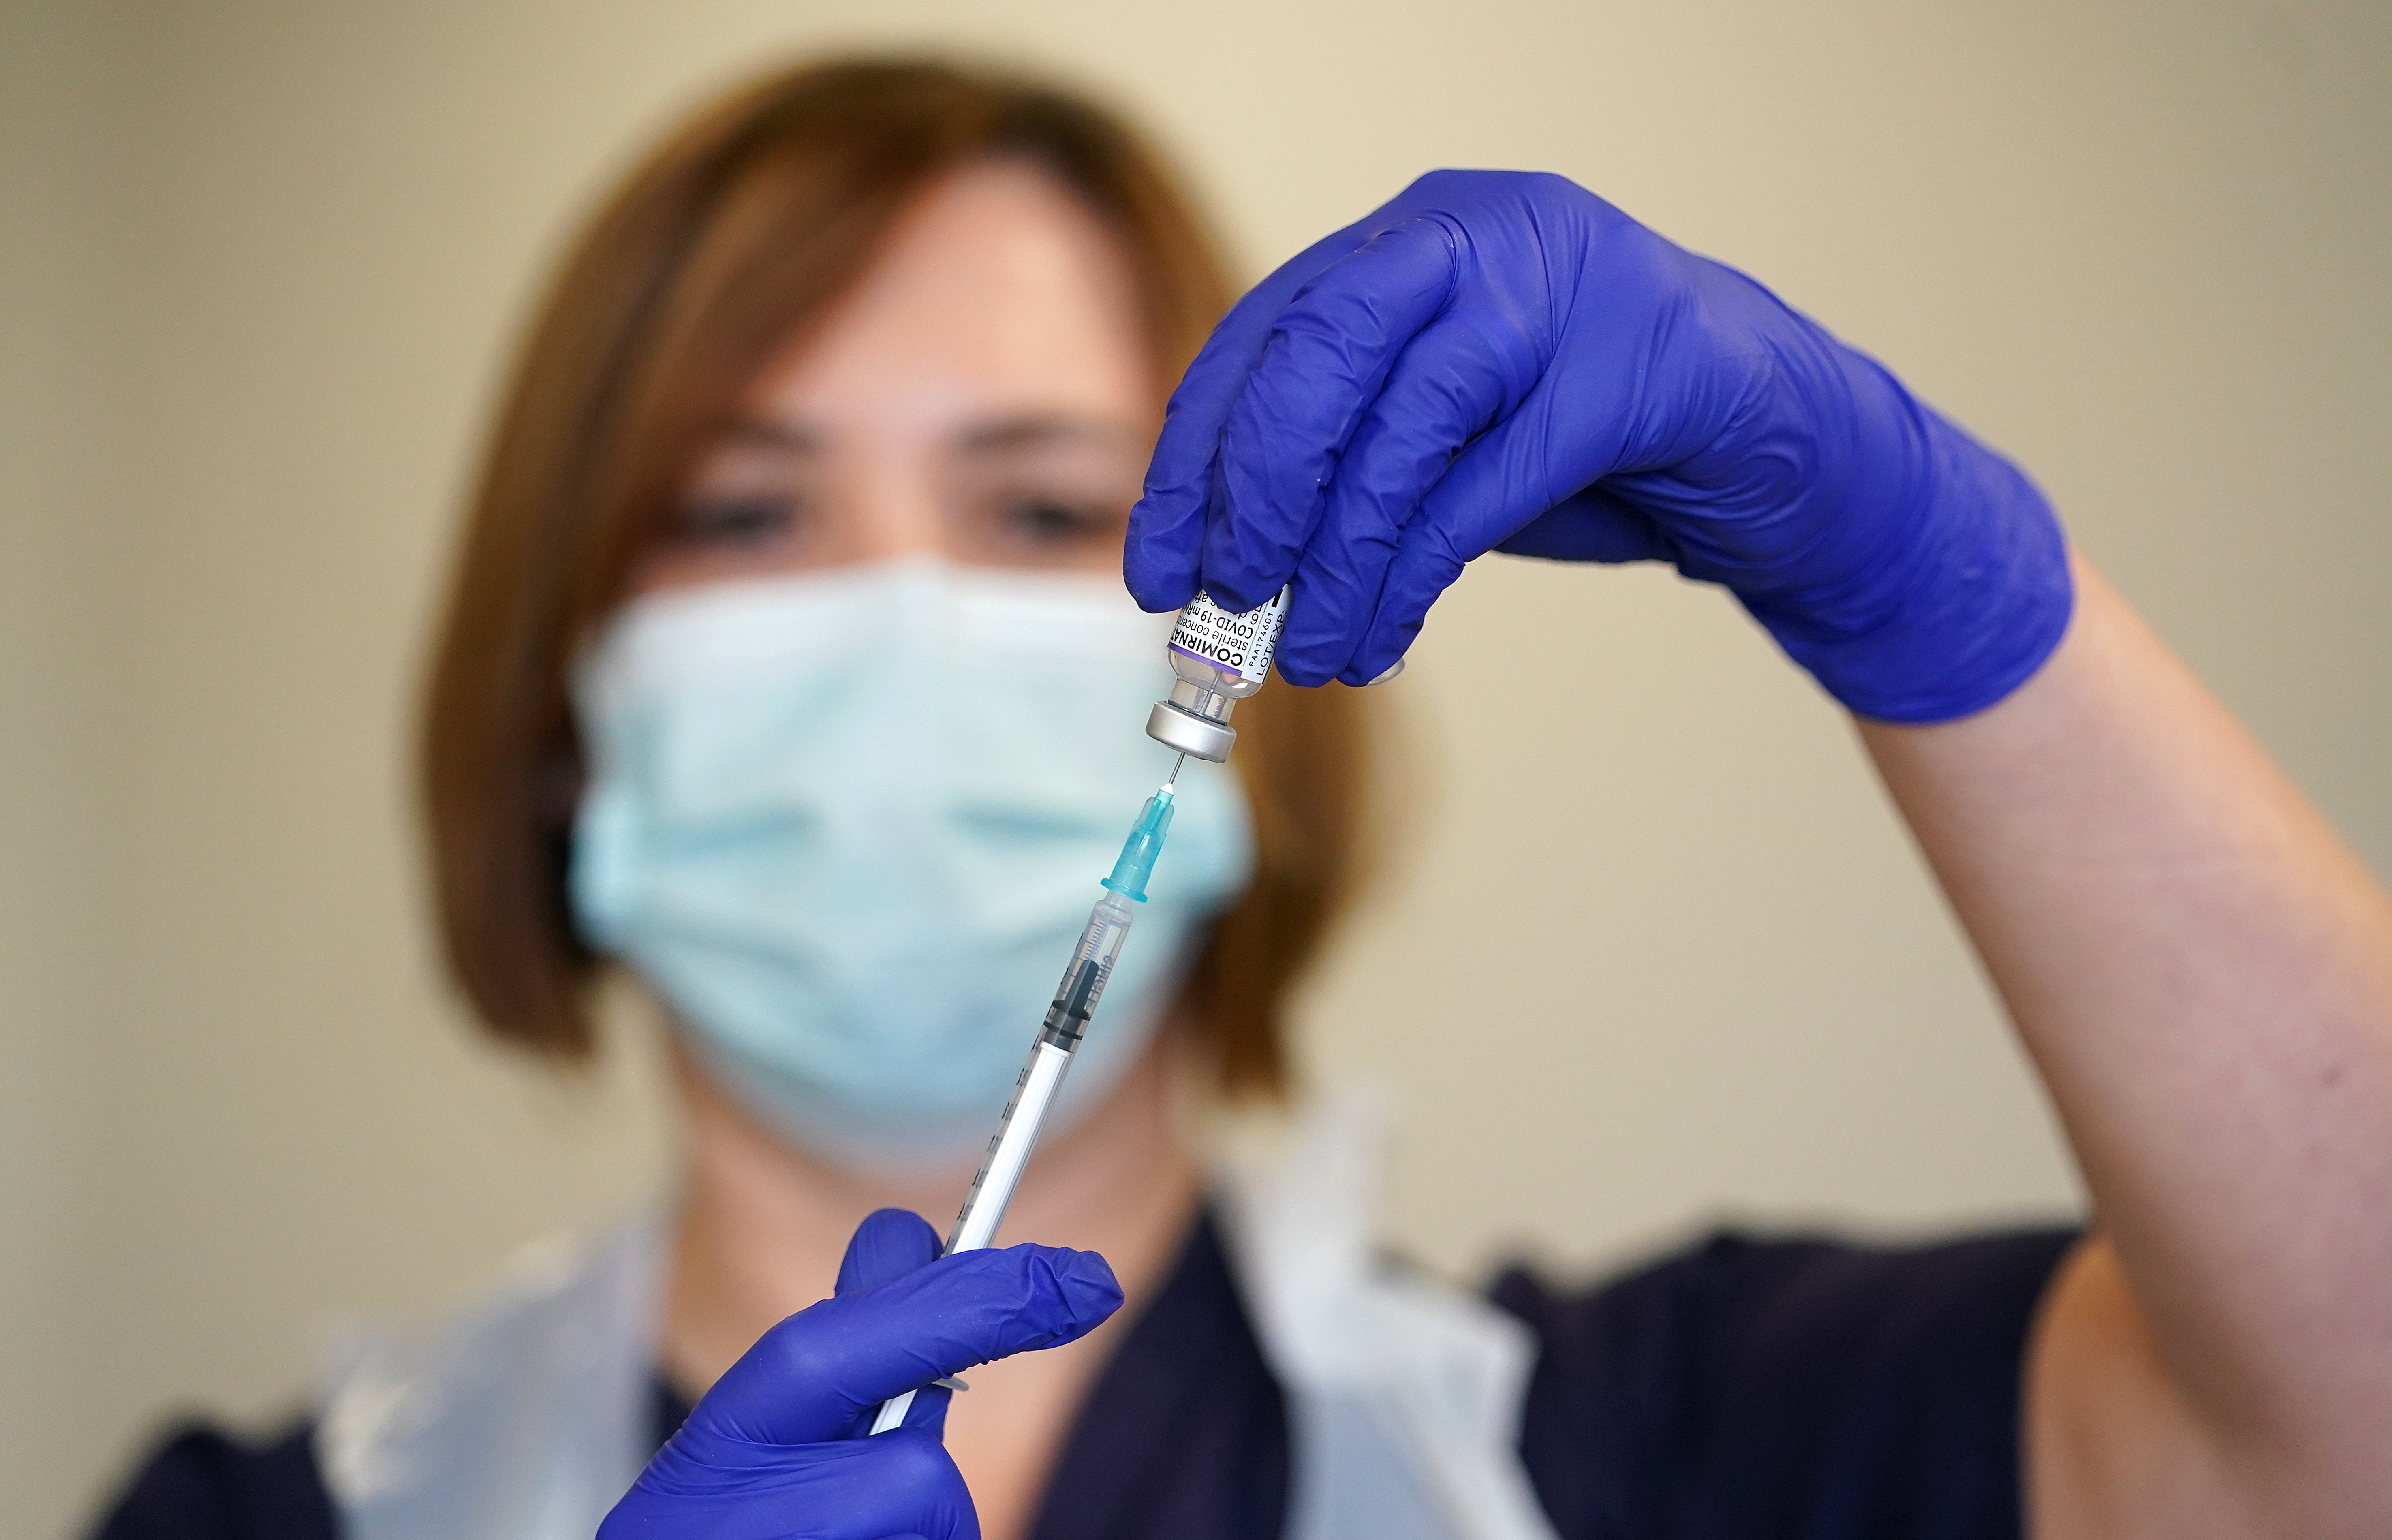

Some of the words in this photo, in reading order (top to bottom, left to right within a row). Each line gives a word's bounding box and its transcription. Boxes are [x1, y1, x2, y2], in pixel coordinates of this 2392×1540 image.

[1201, 610, 1253, 639] COVID-19
[1250, 613, 1259, 625] 6
[1212, 631, 1248, 651] sterile
[1249, 613, 1274, 667] PAA174601
[1256, 610, 1287, 676] LOT/EXP:
